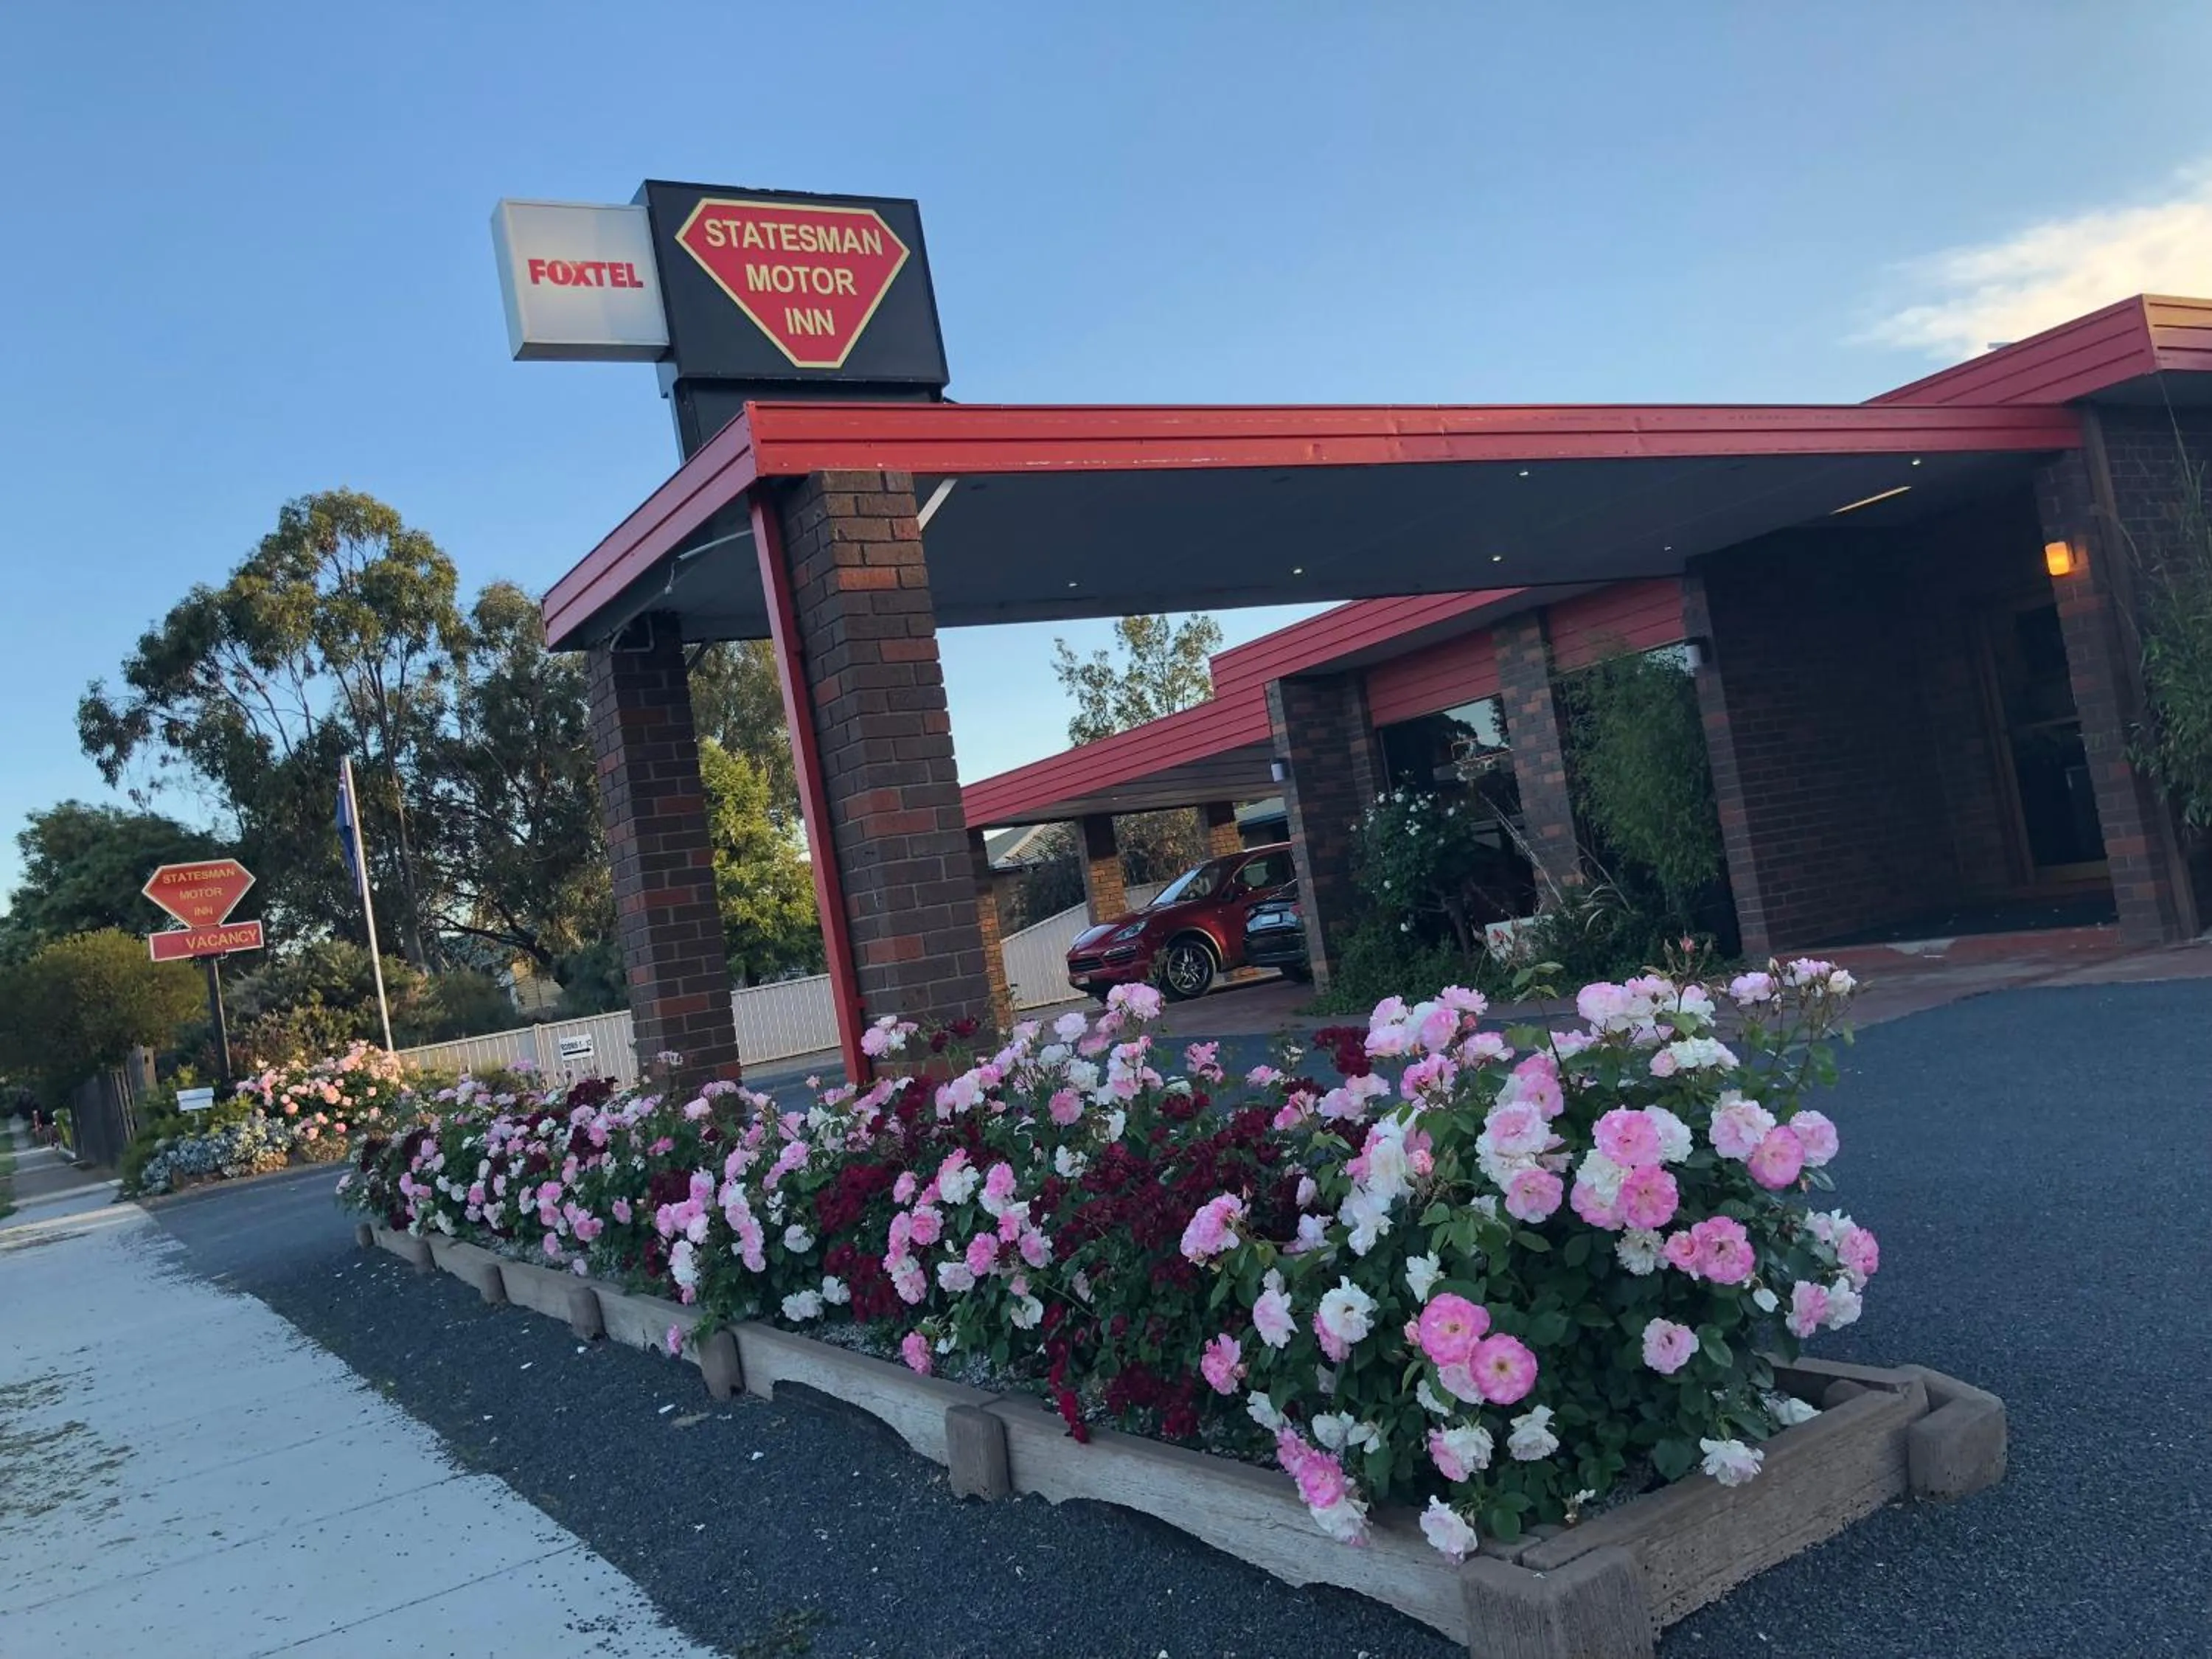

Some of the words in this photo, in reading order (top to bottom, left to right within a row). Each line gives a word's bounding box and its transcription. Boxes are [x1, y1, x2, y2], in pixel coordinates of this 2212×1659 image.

[706, 219, 883, 255] STATESMAN
[529, 259, 644, 288] FOXTEL
[746, 264, 857, 295] MOTOR
[785, 307, 835, 335] INN
[163, 868, 235, 883] STATESMAN
[179, 887, 223, 900] MOTOR
[194, 906, 213, 917] INN
[186, 930, 257, 950] VACANCY
